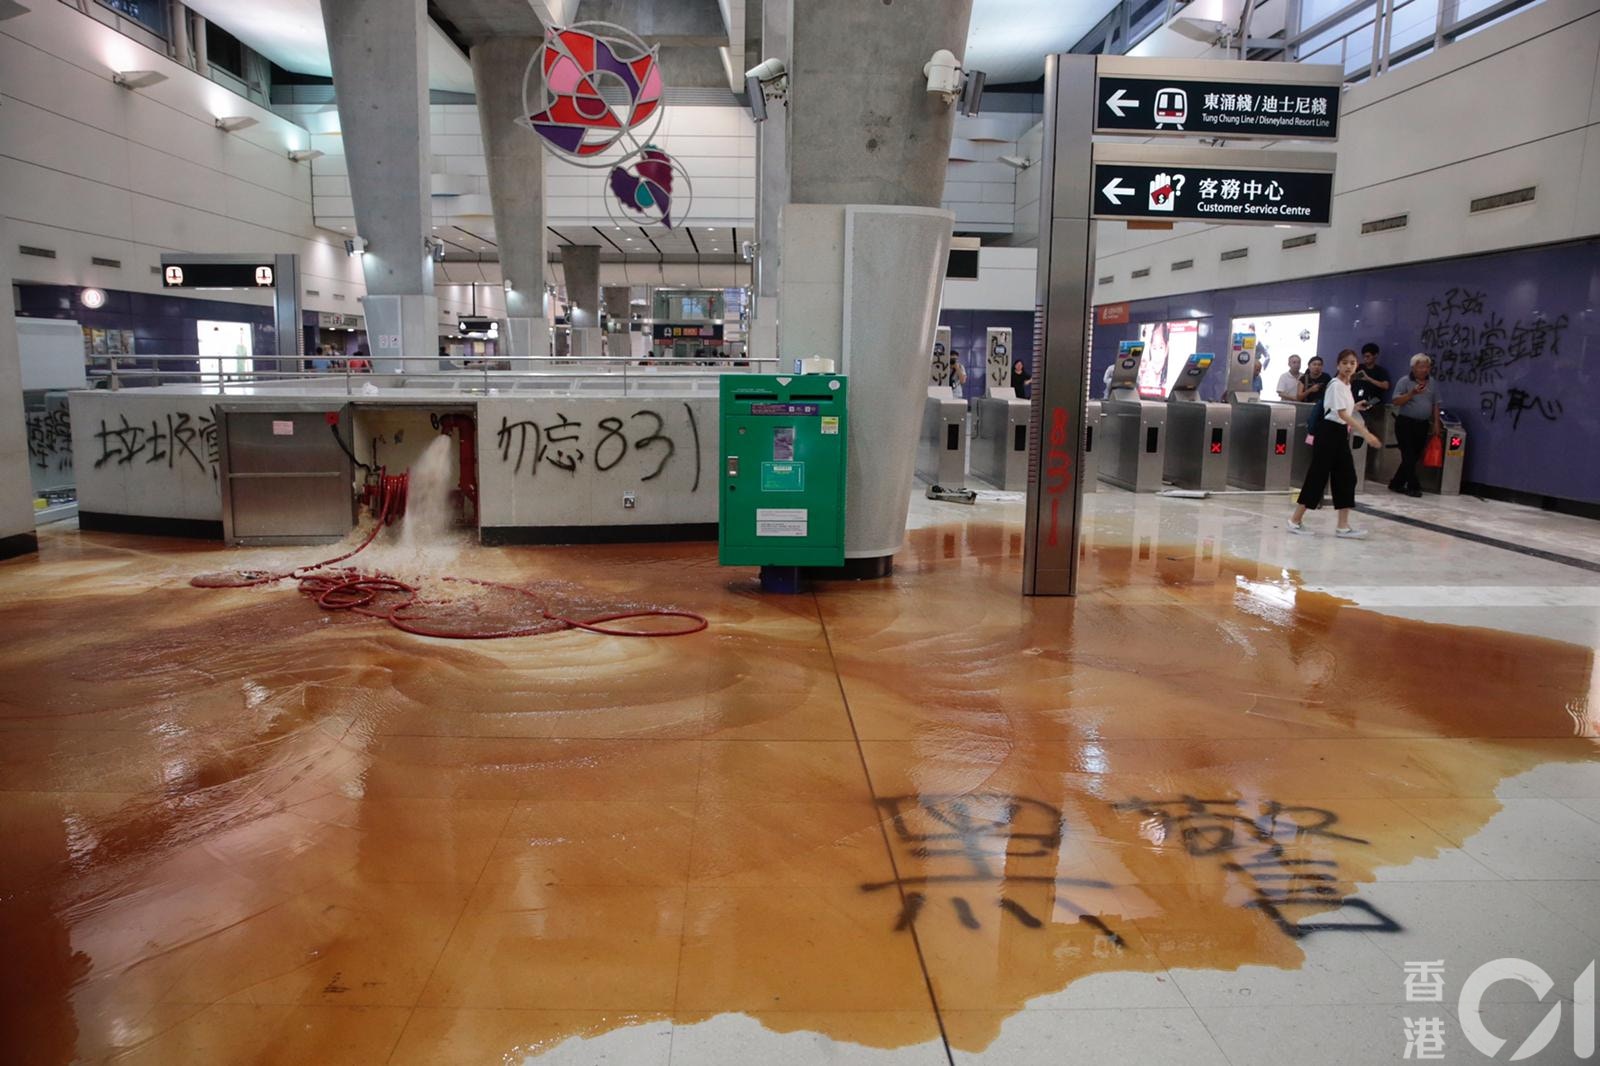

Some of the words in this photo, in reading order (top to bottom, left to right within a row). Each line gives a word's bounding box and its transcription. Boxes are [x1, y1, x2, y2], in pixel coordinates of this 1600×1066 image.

[1202, 113, 1219, 125] Tung
[1219, 114, 1240, 125] Chung
[1240, 115, 1255, 124] Line
[1259, 116, 1294, 127] Disneyland
[1294, 117, 1316, 127] Resort
[1316, 118, 1330, 127] Line
[1198, 178, 1284, 201] 客務中心
[1197, 201, 1243, 213] Customer
[1244, 203, 1278, 214] Service
[1279, 204, 1311, 216] Centre
